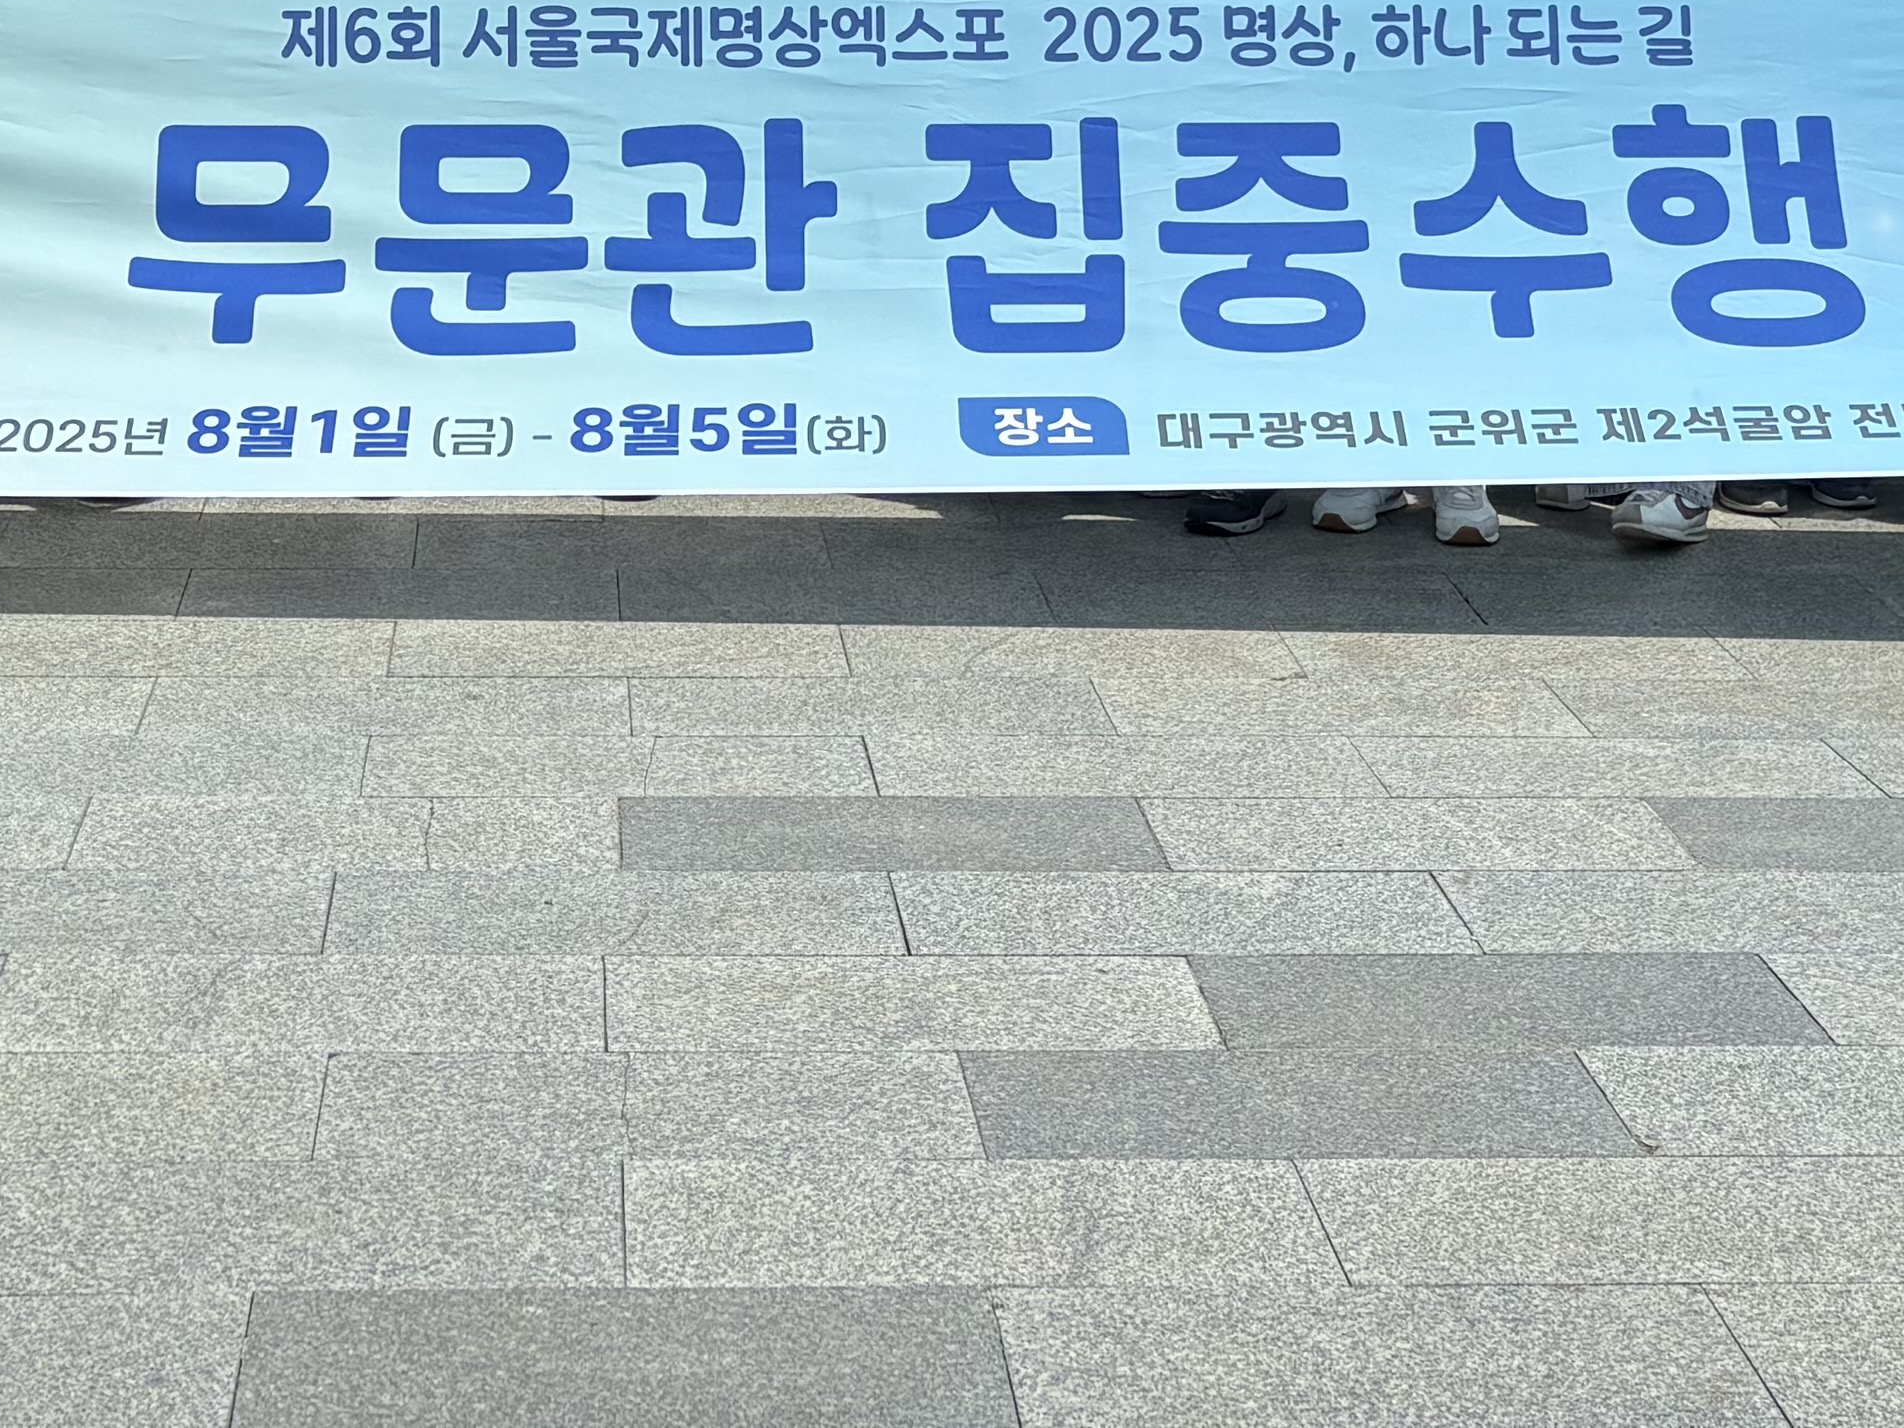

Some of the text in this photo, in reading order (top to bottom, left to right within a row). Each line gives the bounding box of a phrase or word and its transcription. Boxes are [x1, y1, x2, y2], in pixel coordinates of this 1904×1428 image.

[281, 5, 441, 68] 제6회
[462, 5, 1009, 69] 서울국제명상엑스포
[1043, 6, 1203, 63] 2025
[1223, 3, 1356, 73] 명상,
[1371, 3, 1492, 66] 하나
[127, 103, 1867, 357] 무문관 집중수행
[432, 416, 514, 458] (금)
[993, 406, 1095, 447] 장소
[1156, 410, 1408, 450] 대구광역시
[1428, 408, 1579, 447] 군위군
[1595, 404, 1833, 443] 제2석굴암
